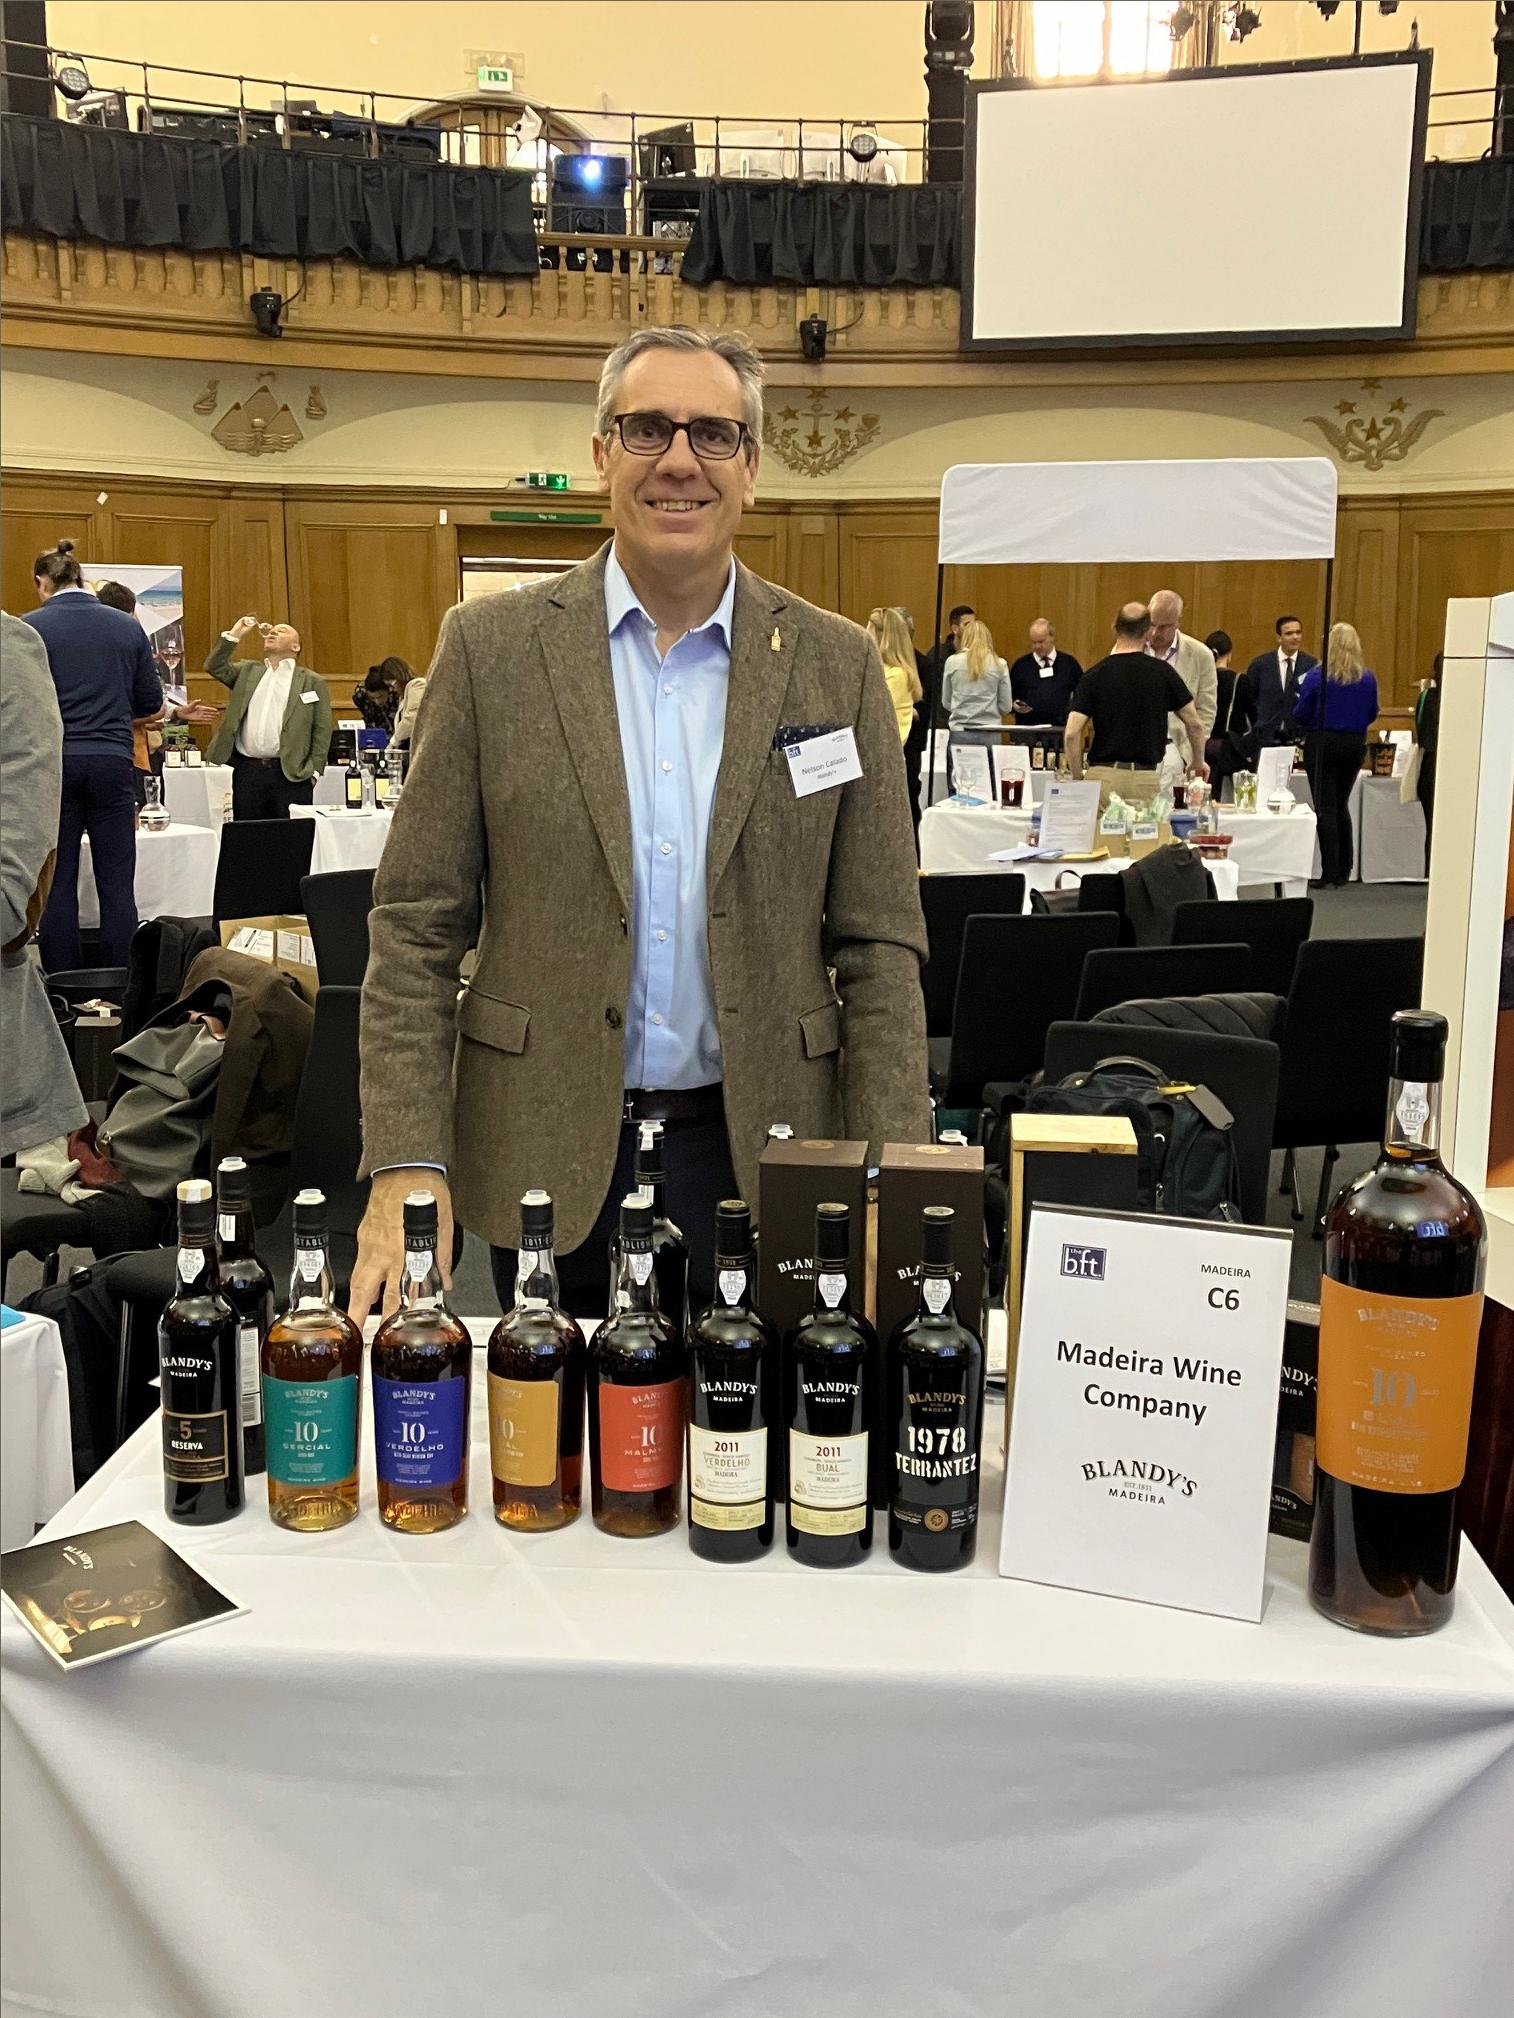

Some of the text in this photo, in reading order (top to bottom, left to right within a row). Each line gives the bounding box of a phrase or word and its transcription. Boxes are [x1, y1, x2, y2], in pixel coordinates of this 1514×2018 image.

[802, 763, 825, 776] Nelson
[1200, 1264, 1252, 1279] MADEIRA
[1208, 1286, 1241, 1311] C6
[1057, 1340, 1242, 1387] Madeira Wine
[700, 1381, 758, 1396] BLANDY'S
[802, 1382, 860, 1396] BLANDY'S
[1372, 1367, 1418, 1409] 10
[908, 1392, 966, 1405] BLANDY'S
[1084, 1384, 1208, 1426] Company
[179, 1421, 192, 1440] 5
[295, 1421, 319, 1442] 10
[401, 1422, 426, 1444] 10
[171, 1440, 204, 1450] RESERVA
[282, 1443, 332, 1451] SERCIAL
[386, 1444, 444, 1452] VERDELHO
[714, 1441, 740, 1452] 2011
[908, 1426, 966, 1456] 1978
[816, 1446, 842, 1458] 2011
[704, 1456, 751, 1468] VERDELHO
[816, 1463, 840, 1473] BUAL
[896, 1452, 977, 1478] TERRANTEZ
[1081, 1459, 1198, 1497] BLANDY'S
[1108, 1488, 1166, 1505] MADEIRA
